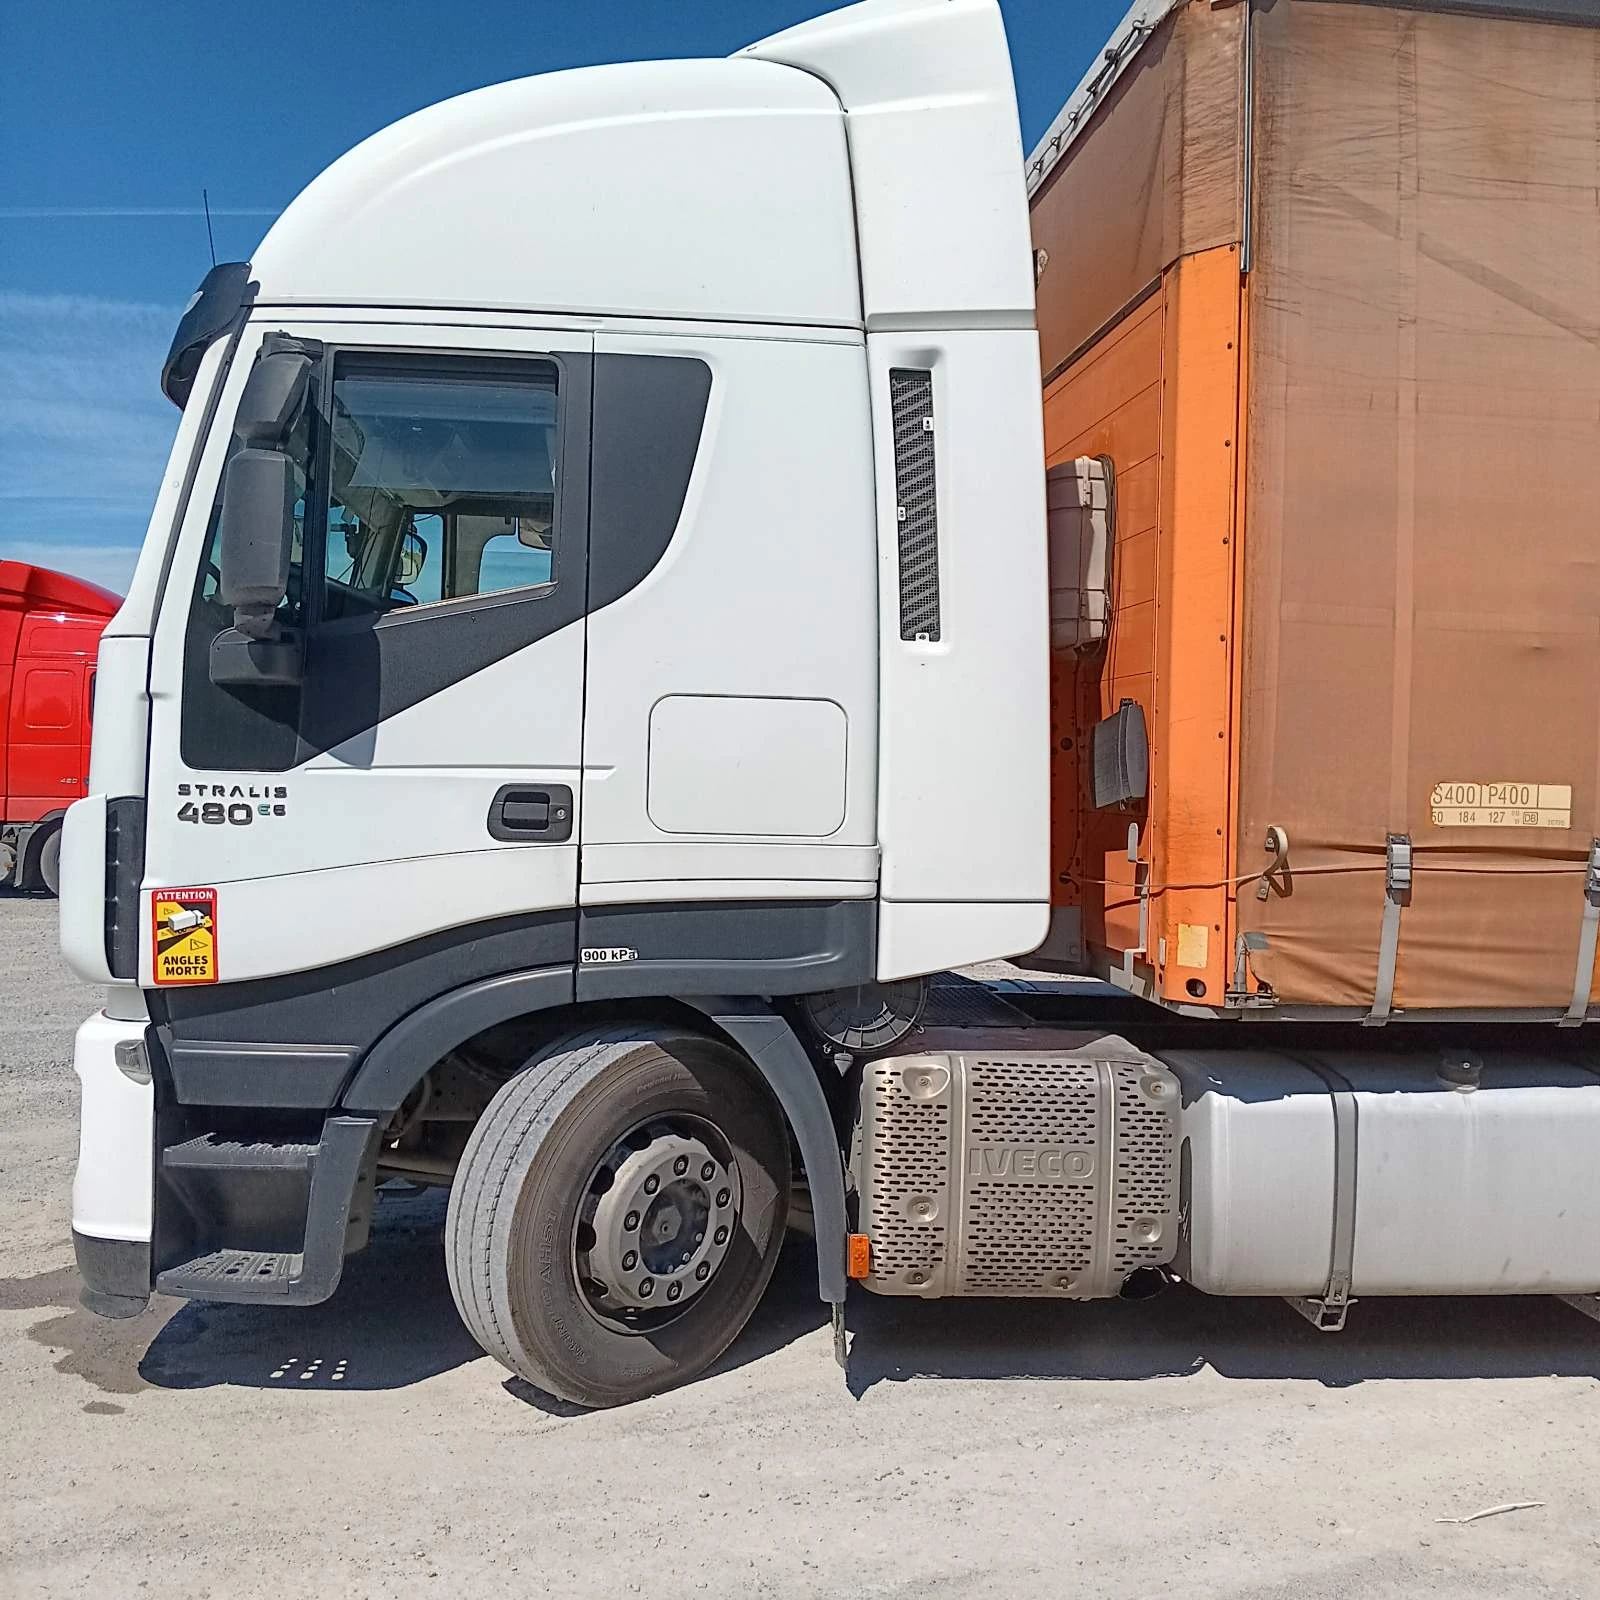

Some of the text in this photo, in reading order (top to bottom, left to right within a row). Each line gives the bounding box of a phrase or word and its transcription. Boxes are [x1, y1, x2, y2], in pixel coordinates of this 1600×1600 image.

[178, 783, 288, 799] STRALIS
[1433, 785, 1530, 806] S400 P400
[177, 801, 253, 826] 480
[1459, 811, 1476, 823] 184
[1488, 811, 1506, 823] 127
[156, 890, 214, 902] ATTENTION
[163, 955, 208, 966] ANGLES
[583, 949, 636, 961] 900 kPa
[165, 965, 207, 976] MORTS
[969, 1148, 1095, 1179] IVECO
